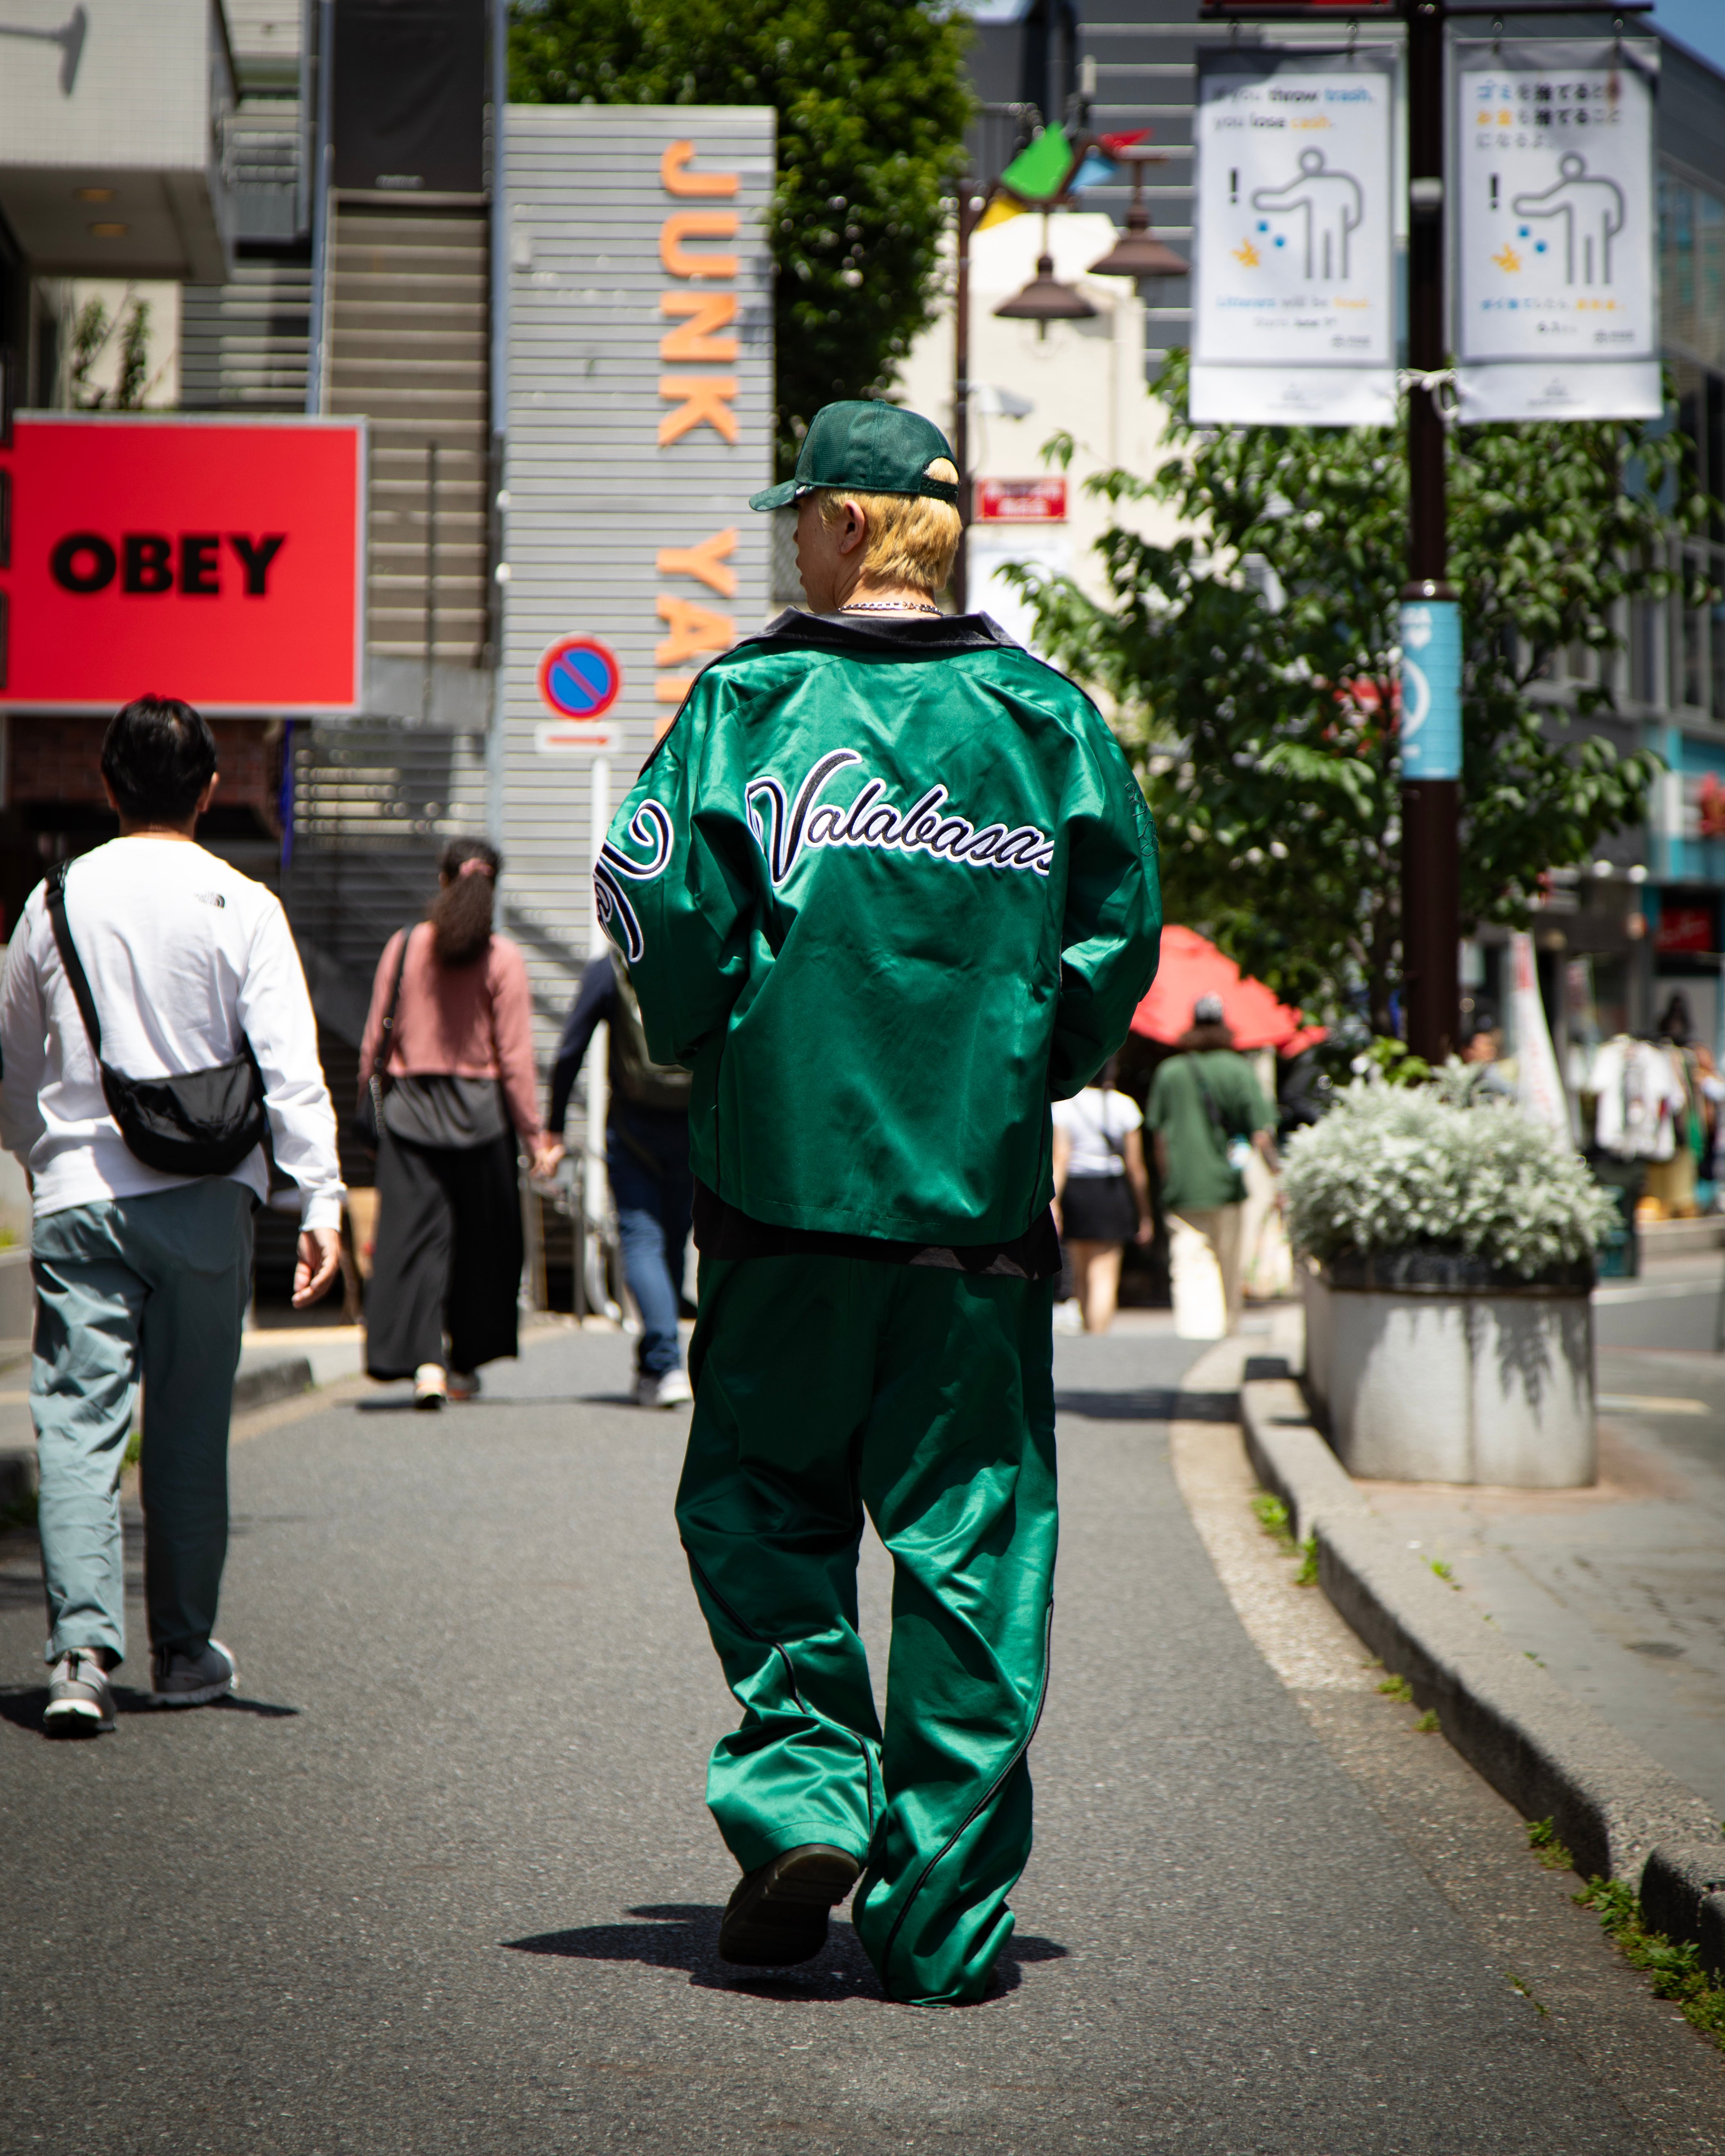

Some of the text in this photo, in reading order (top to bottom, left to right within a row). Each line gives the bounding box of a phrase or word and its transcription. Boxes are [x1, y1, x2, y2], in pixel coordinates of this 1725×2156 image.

[50, 531, 287, 596] OBEY
[655, 138, 740, 743] JUNK YA
